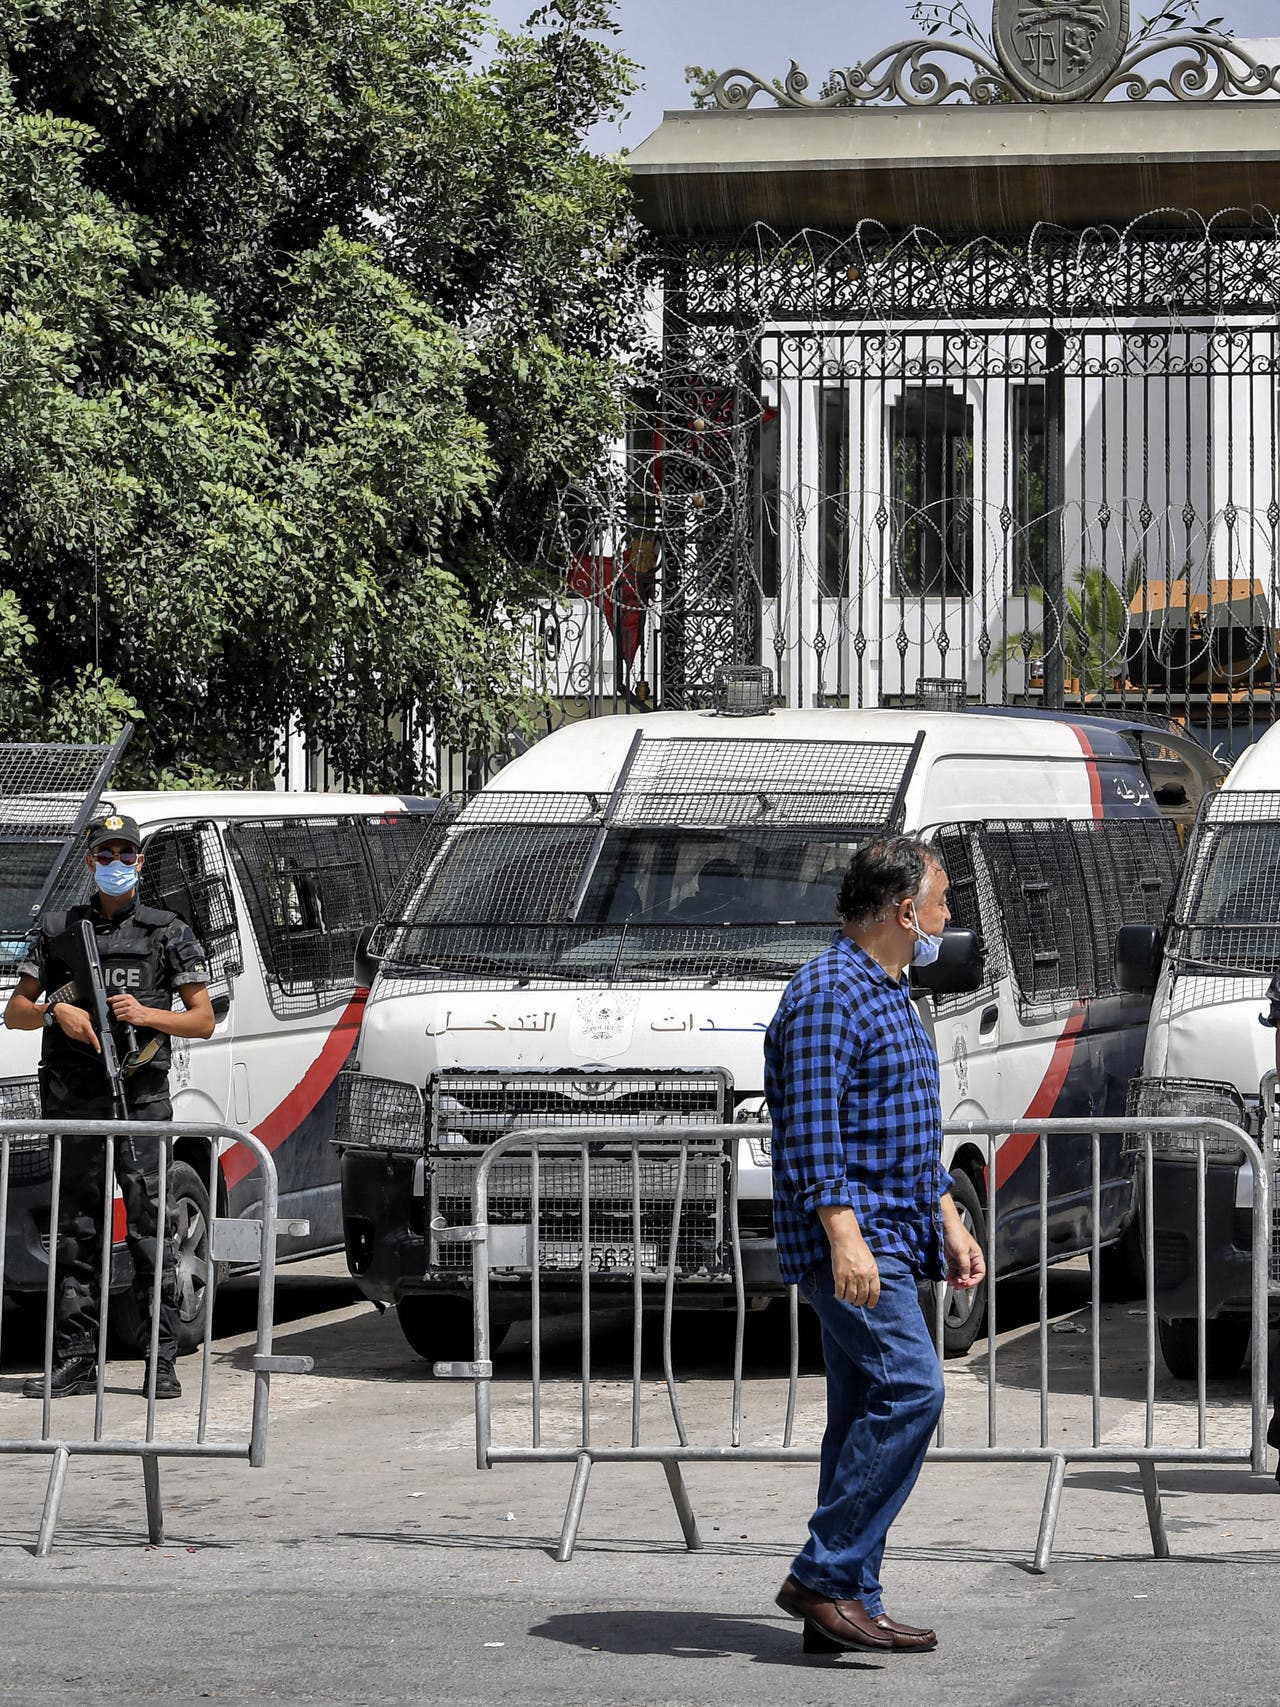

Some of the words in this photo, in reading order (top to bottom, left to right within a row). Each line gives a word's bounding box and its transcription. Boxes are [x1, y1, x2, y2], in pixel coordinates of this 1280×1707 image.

[105, 968, 140, 987] ICE
[425, 1011, 555, 1037] التدخل
[650, 1013, 769, 1032] حدات
